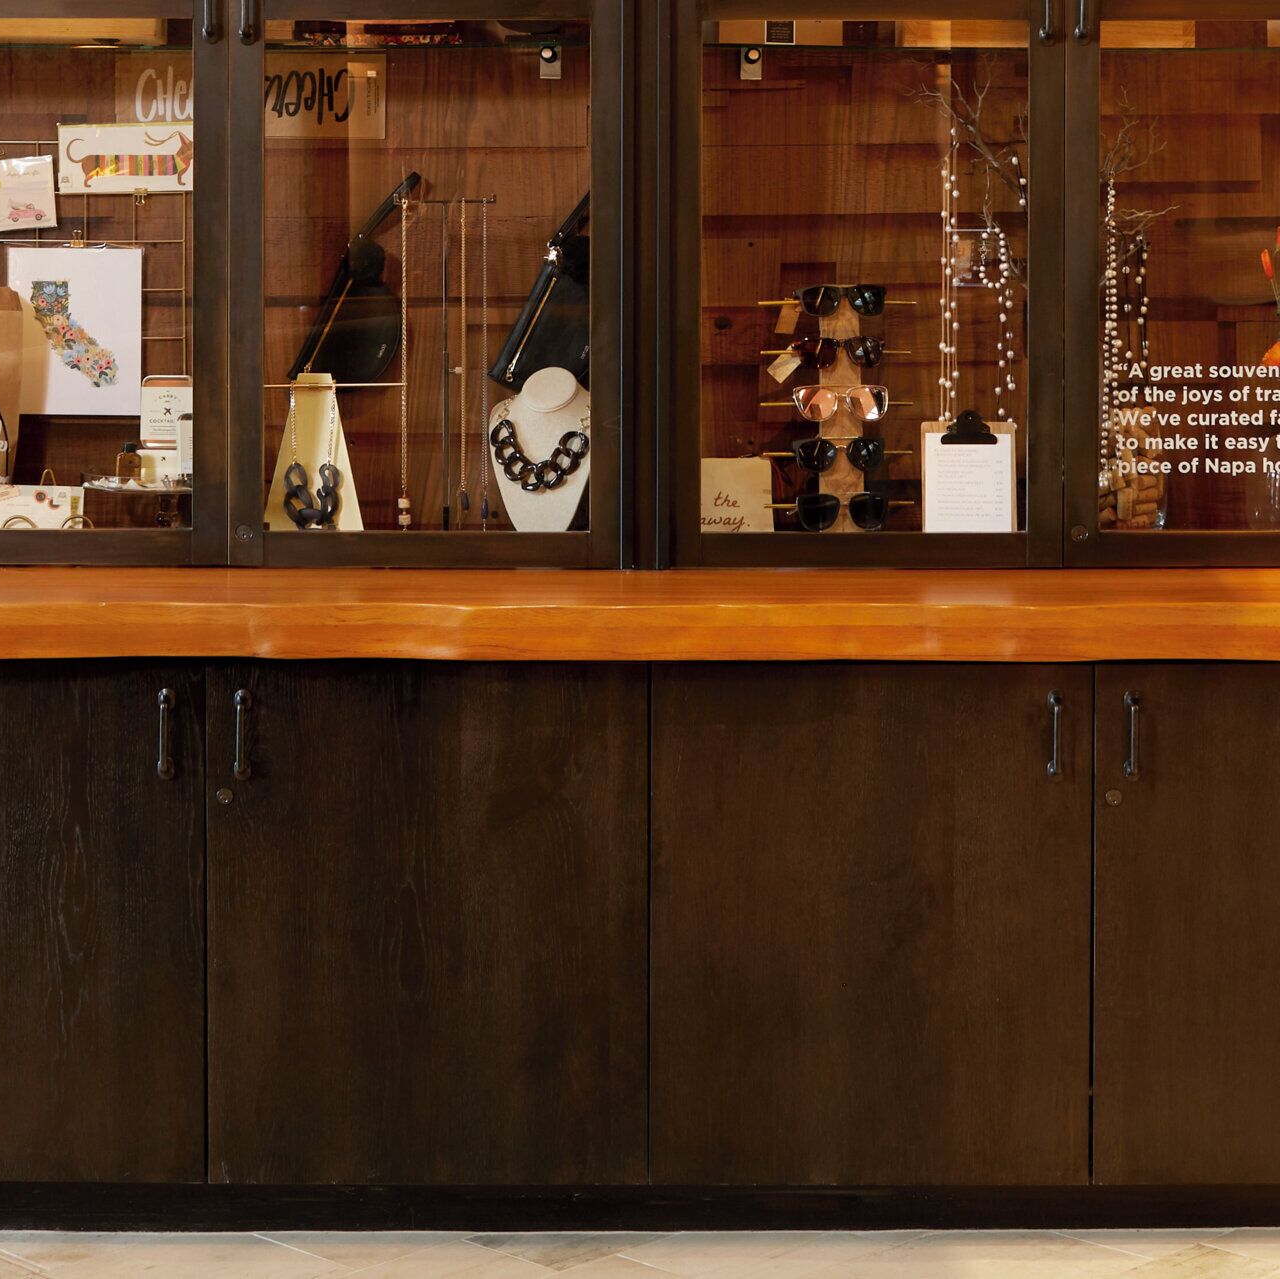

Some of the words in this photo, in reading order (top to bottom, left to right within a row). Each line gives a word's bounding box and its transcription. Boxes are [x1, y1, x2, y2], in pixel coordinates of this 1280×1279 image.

[1150, 364, 1203, 380] great
[1117, 386, 1138, 402] of
[1144, 386, 1176, 402] the
[1181, 386, 1223, 405] joys
[1229, 386, 1250, 402] of
[1118, 411, 1181, 426] We've
[1187, 410, 1264, 426] curated
[1118, 436, 1139, 450] to
[1144, 434, 1198, 450] make
[1204, 434, 1219, 450] it
[1224, 437, 1270, 453] easy
[1118, 457, 1172, 477] piece
[1178, 457, 1199, 473] of
[1205, 458, 1256, 476] Napa
[713, 490, 741, 508] the
